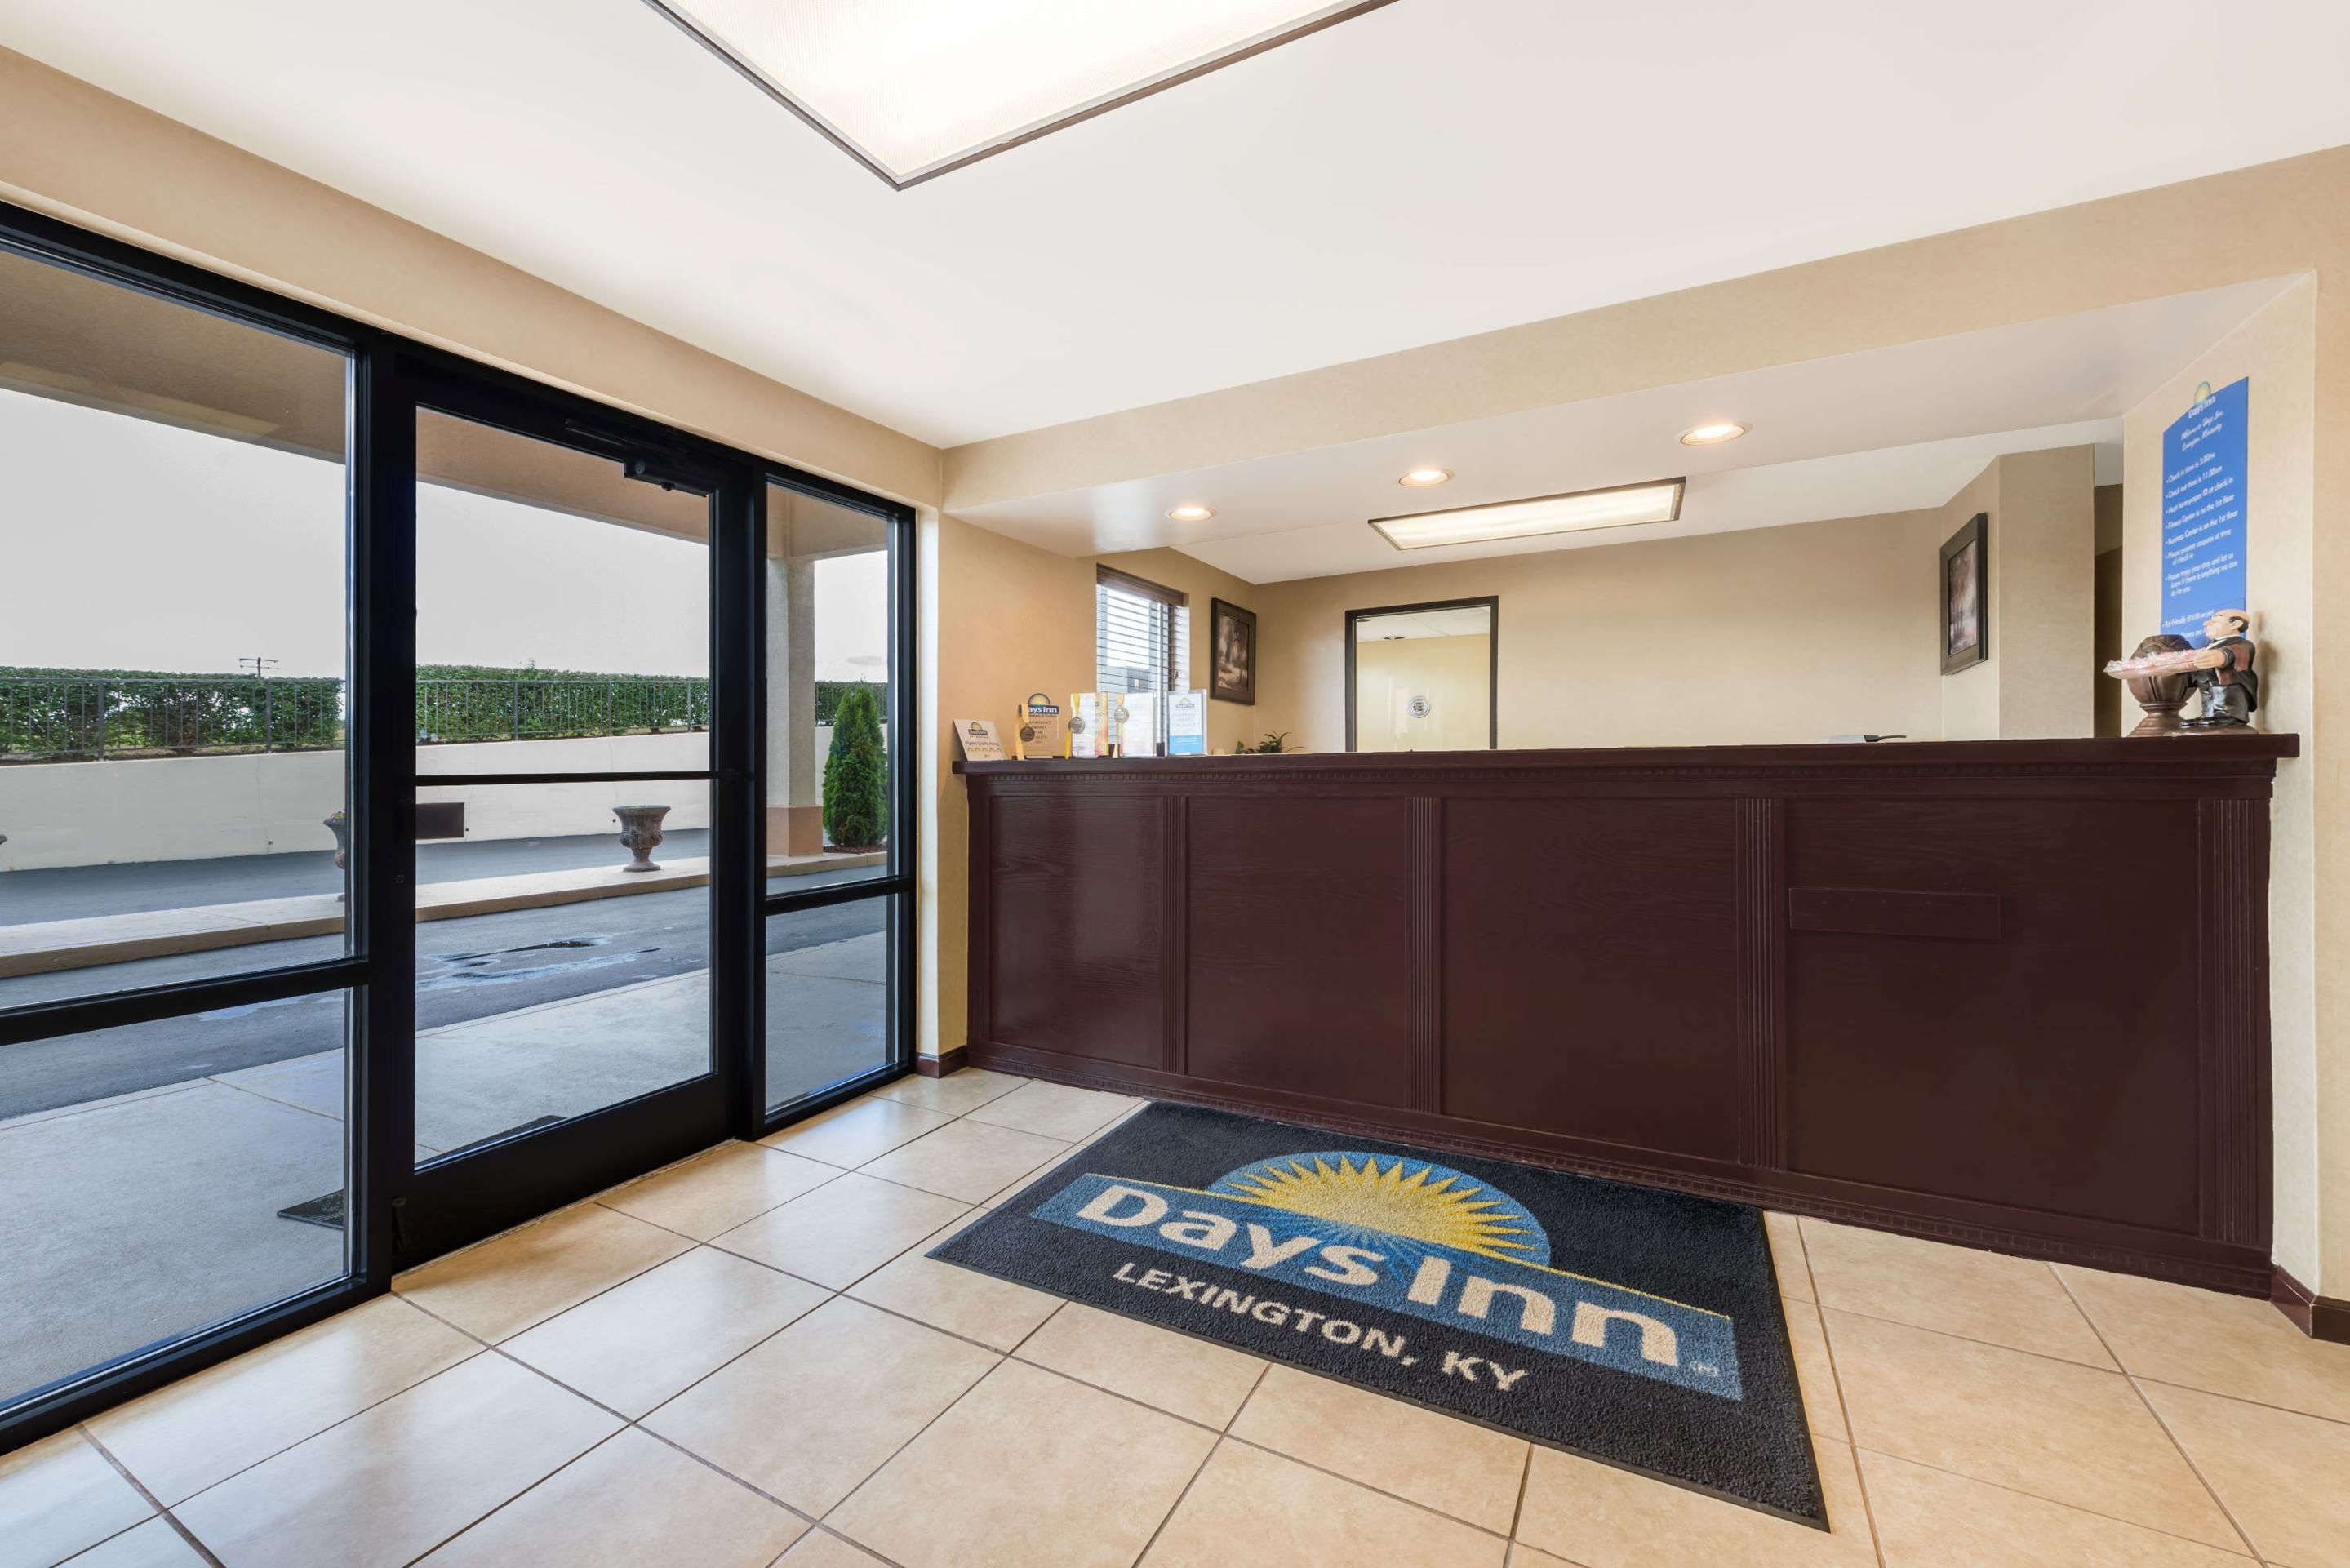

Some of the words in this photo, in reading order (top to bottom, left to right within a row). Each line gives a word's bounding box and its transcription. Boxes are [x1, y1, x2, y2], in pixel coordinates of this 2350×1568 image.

[2168, 470, 2180, 482] Check
[2168, 485, 2180, 499] Check
[2214, 479, 2228, 491] check
[1076, 1184, 1384, 1286] Days
[1407, 1255, 1678, 1367] Inn
[1112, 1262, 1418, 1366] LEXINGTON,
[1442, 1350, 1529, 1392] KY
